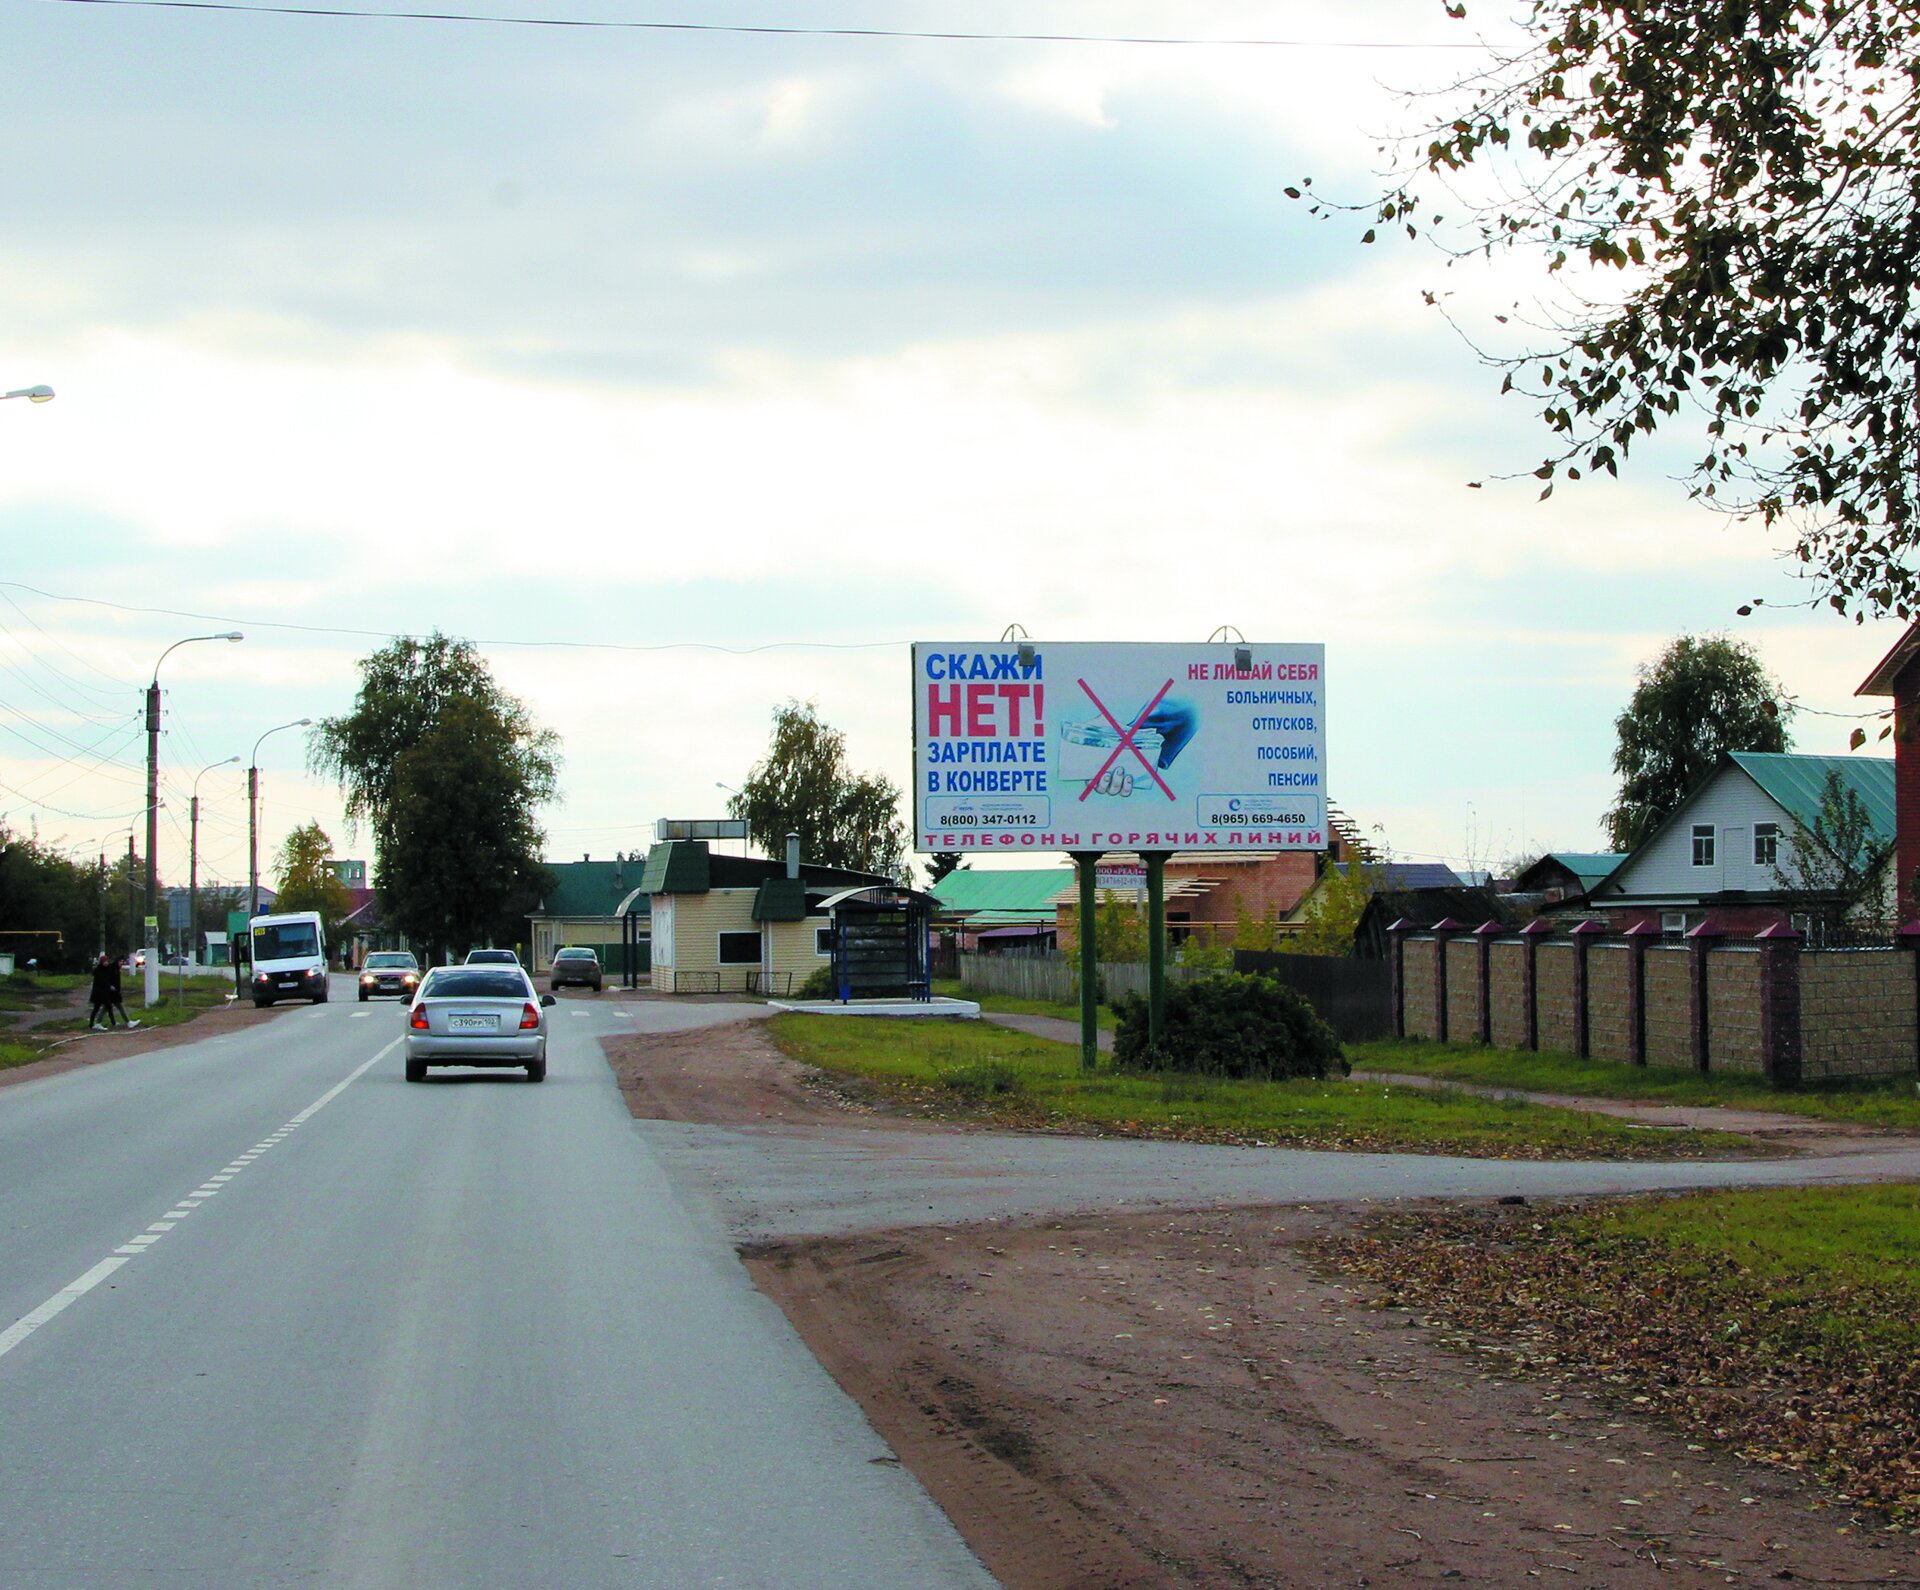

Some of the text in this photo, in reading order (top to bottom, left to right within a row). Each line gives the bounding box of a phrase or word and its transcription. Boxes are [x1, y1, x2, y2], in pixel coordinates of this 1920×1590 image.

[926, 653, 1043, 680] СКАЖИ
[1188, 664, 1209, 680] НЕ
[1277, 664, 1318, 680] СЕБЯ
[1227, 691, 1317, 707] БОЛЬНИЧНЫХ,
[928, 684, 1044, 737] НЕТ!
[1252, 717, 1317, 734] ОТПУСКОВ,
[928, 742, 1046, 763] ЗАРПЛАТЕ
[1257, 744, 1318, 762] ПОСОБИЙ,
[928, 770, 1047, 792] В КОНВЕРТЕ
[1268, 773, 1318, 786] ПЕНСИИ
[940, 814, 1036, 826] 8(800) 347-0112
[1212, 813, 1306, 825] 8(965) 669-4650
[925, 829, 1321, 846] ТЕЛЕФОНЫ ГОРЯЧИХ ЛИНИЙ
